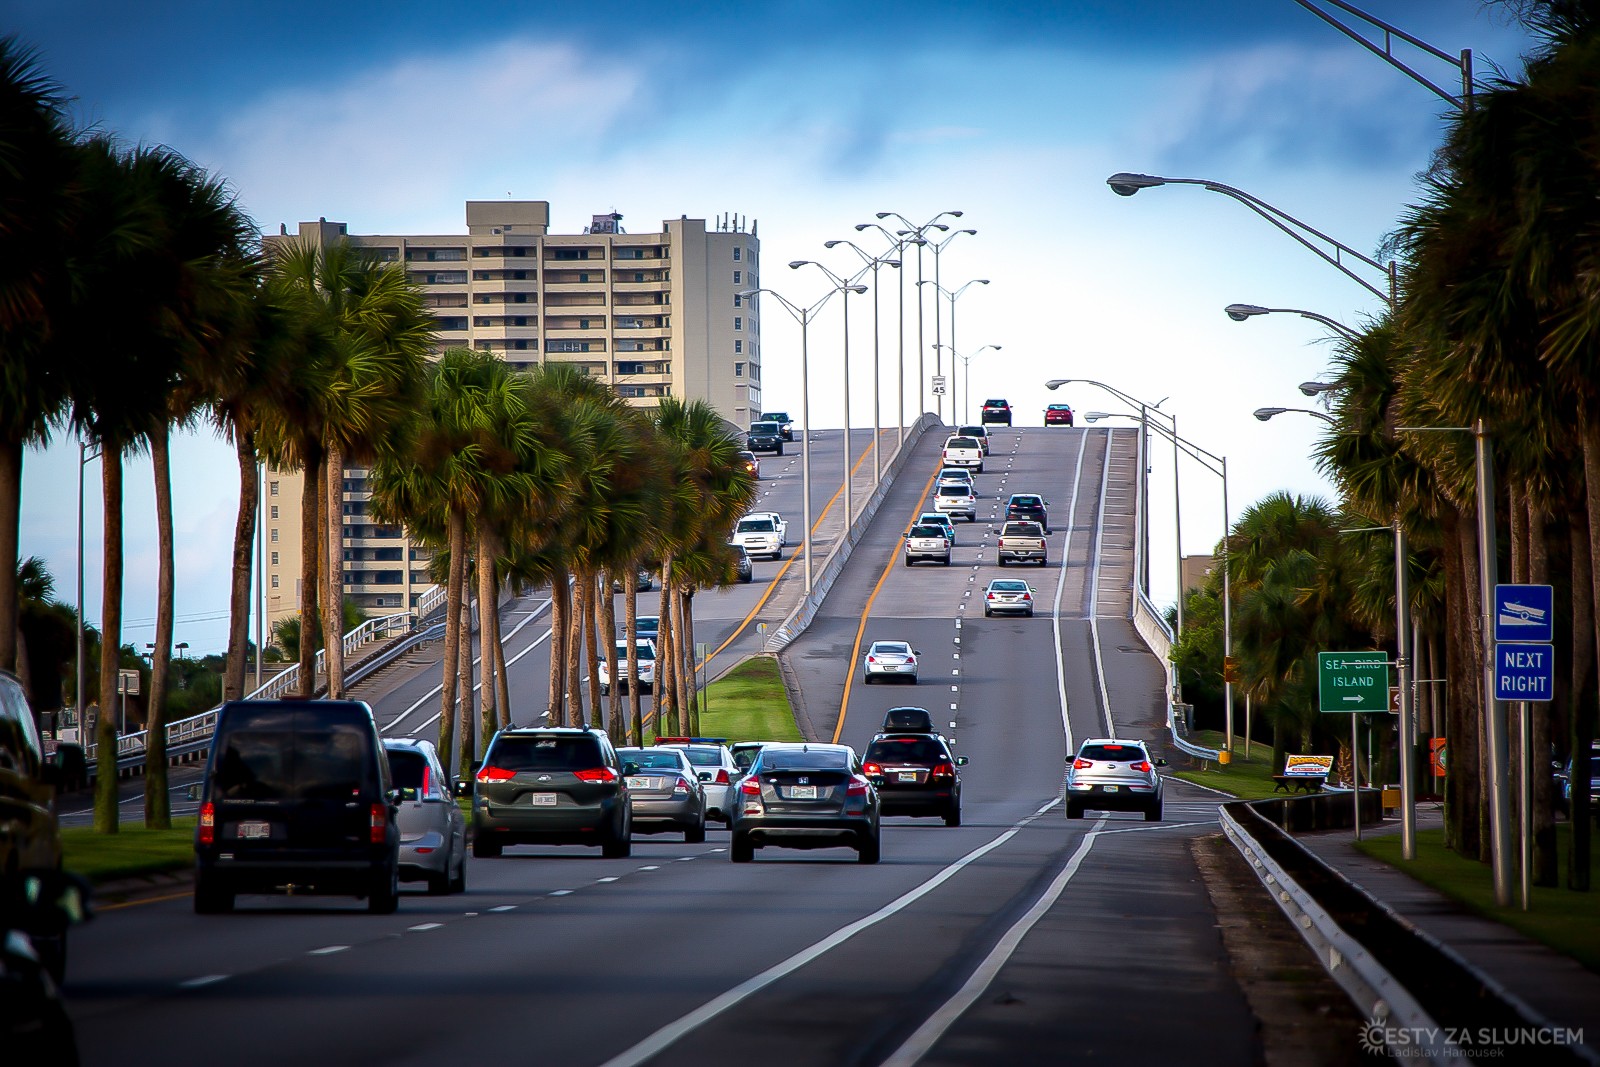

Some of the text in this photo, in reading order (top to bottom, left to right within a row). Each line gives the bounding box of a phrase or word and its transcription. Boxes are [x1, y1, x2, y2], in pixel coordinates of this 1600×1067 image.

[1325, 659, 1382, 670] SEA BIRD
[1505, 652, 1544, 668] NEXT
[1333, 676, 1374, 687] ISLAND
[1501, 675, 1547, 692] RIGHT
